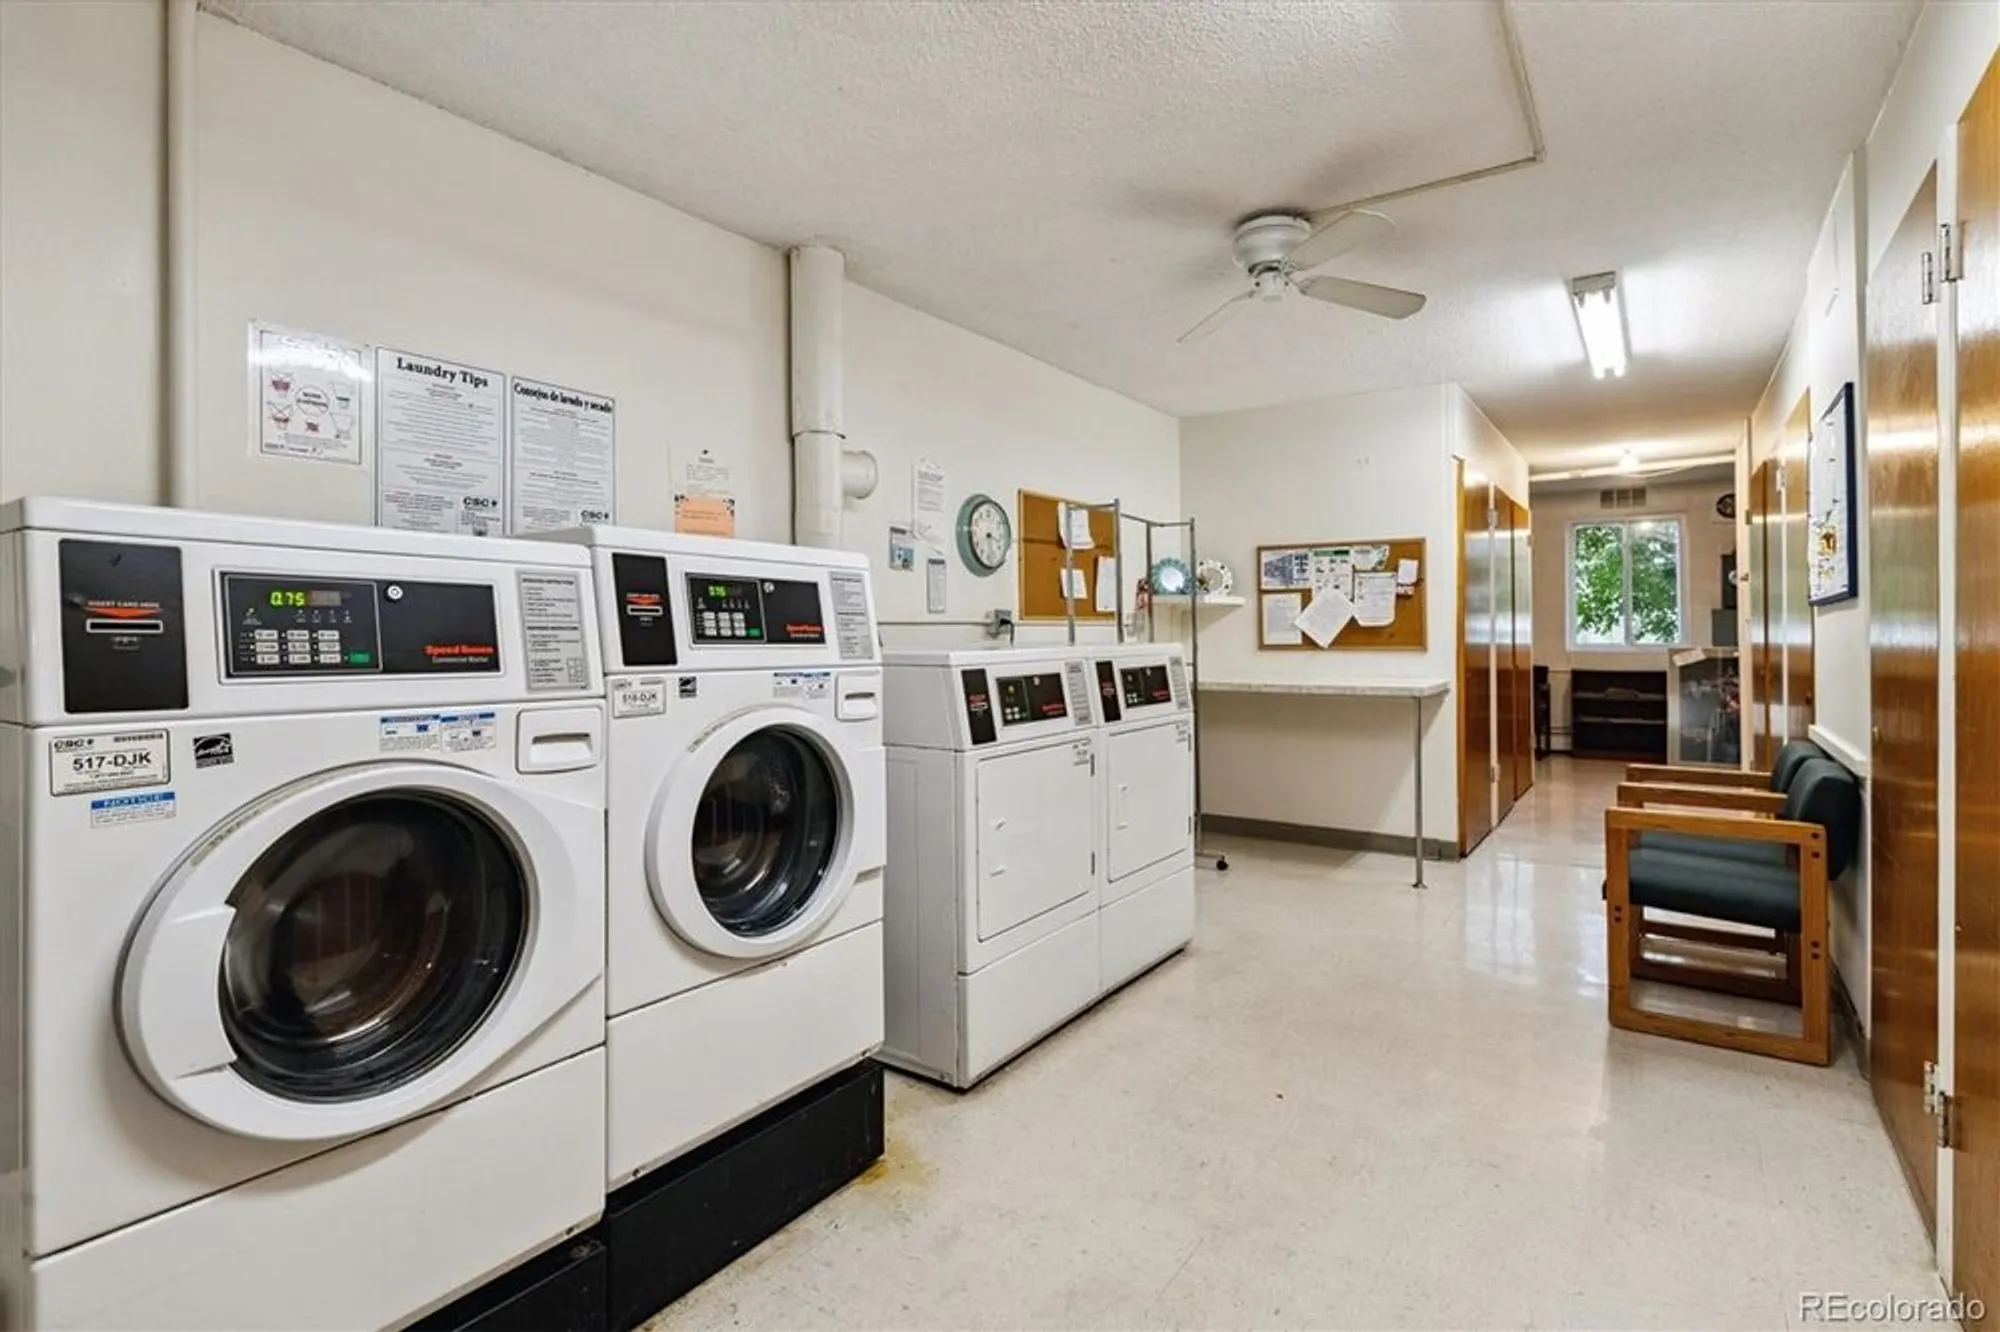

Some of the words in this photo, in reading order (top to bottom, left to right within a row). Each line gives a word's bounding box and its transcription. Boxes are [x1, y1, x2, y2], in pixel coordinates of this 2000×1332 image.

[397, 357, 456, 383] Laundry
[459, 370, 488, 388] Tips
[73, 752, 152, 771] 517-DJK
